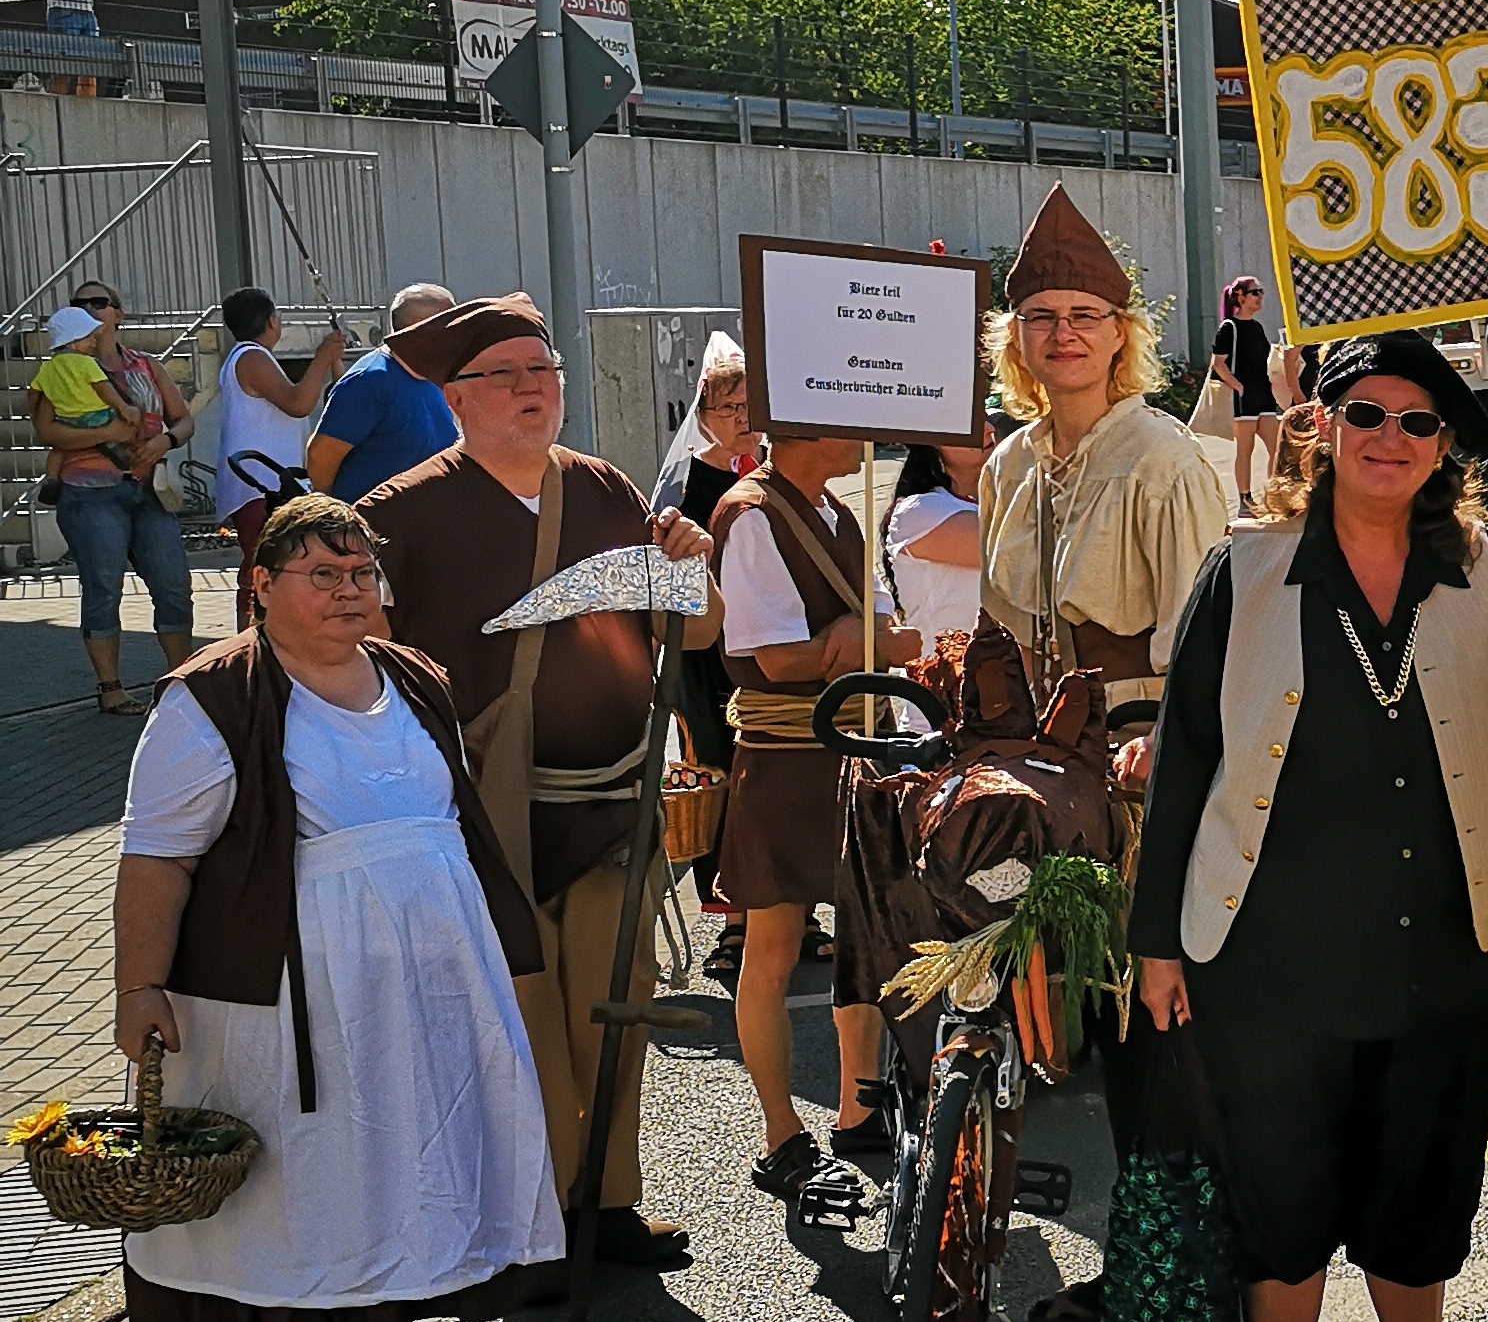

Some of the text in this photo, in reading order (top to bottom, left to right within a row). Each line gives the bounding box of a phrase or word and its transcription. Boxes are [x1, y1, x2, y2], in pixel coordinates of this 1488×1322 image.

[849, 281, 881, 296] Biete
[857, 308, 873, 320] 20
[876, 309, 916, 324] Gulden
[848, 355, 904, 371] Gesunden
[805, 377, 944, 399] Emscherbrücher Dickkopf
